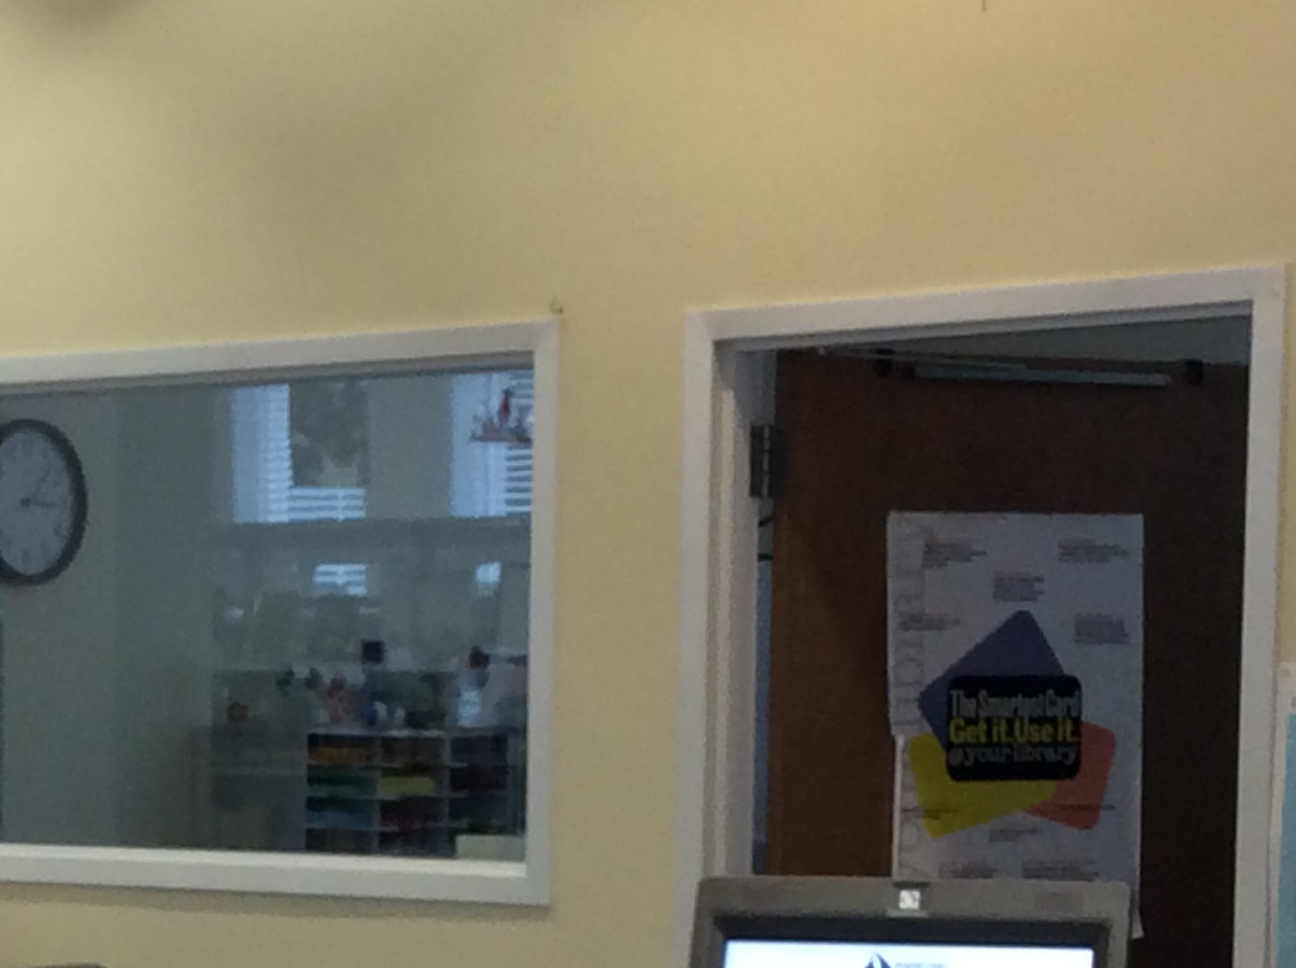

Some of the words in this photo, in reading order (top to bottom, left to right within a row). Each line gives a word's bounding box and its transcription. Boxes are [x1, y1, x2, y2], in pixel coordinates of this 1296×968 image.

[950, 689, 977, 716] The
[948, 717, 988, 744] Get
[1014, 718, 1054, 744] Use
